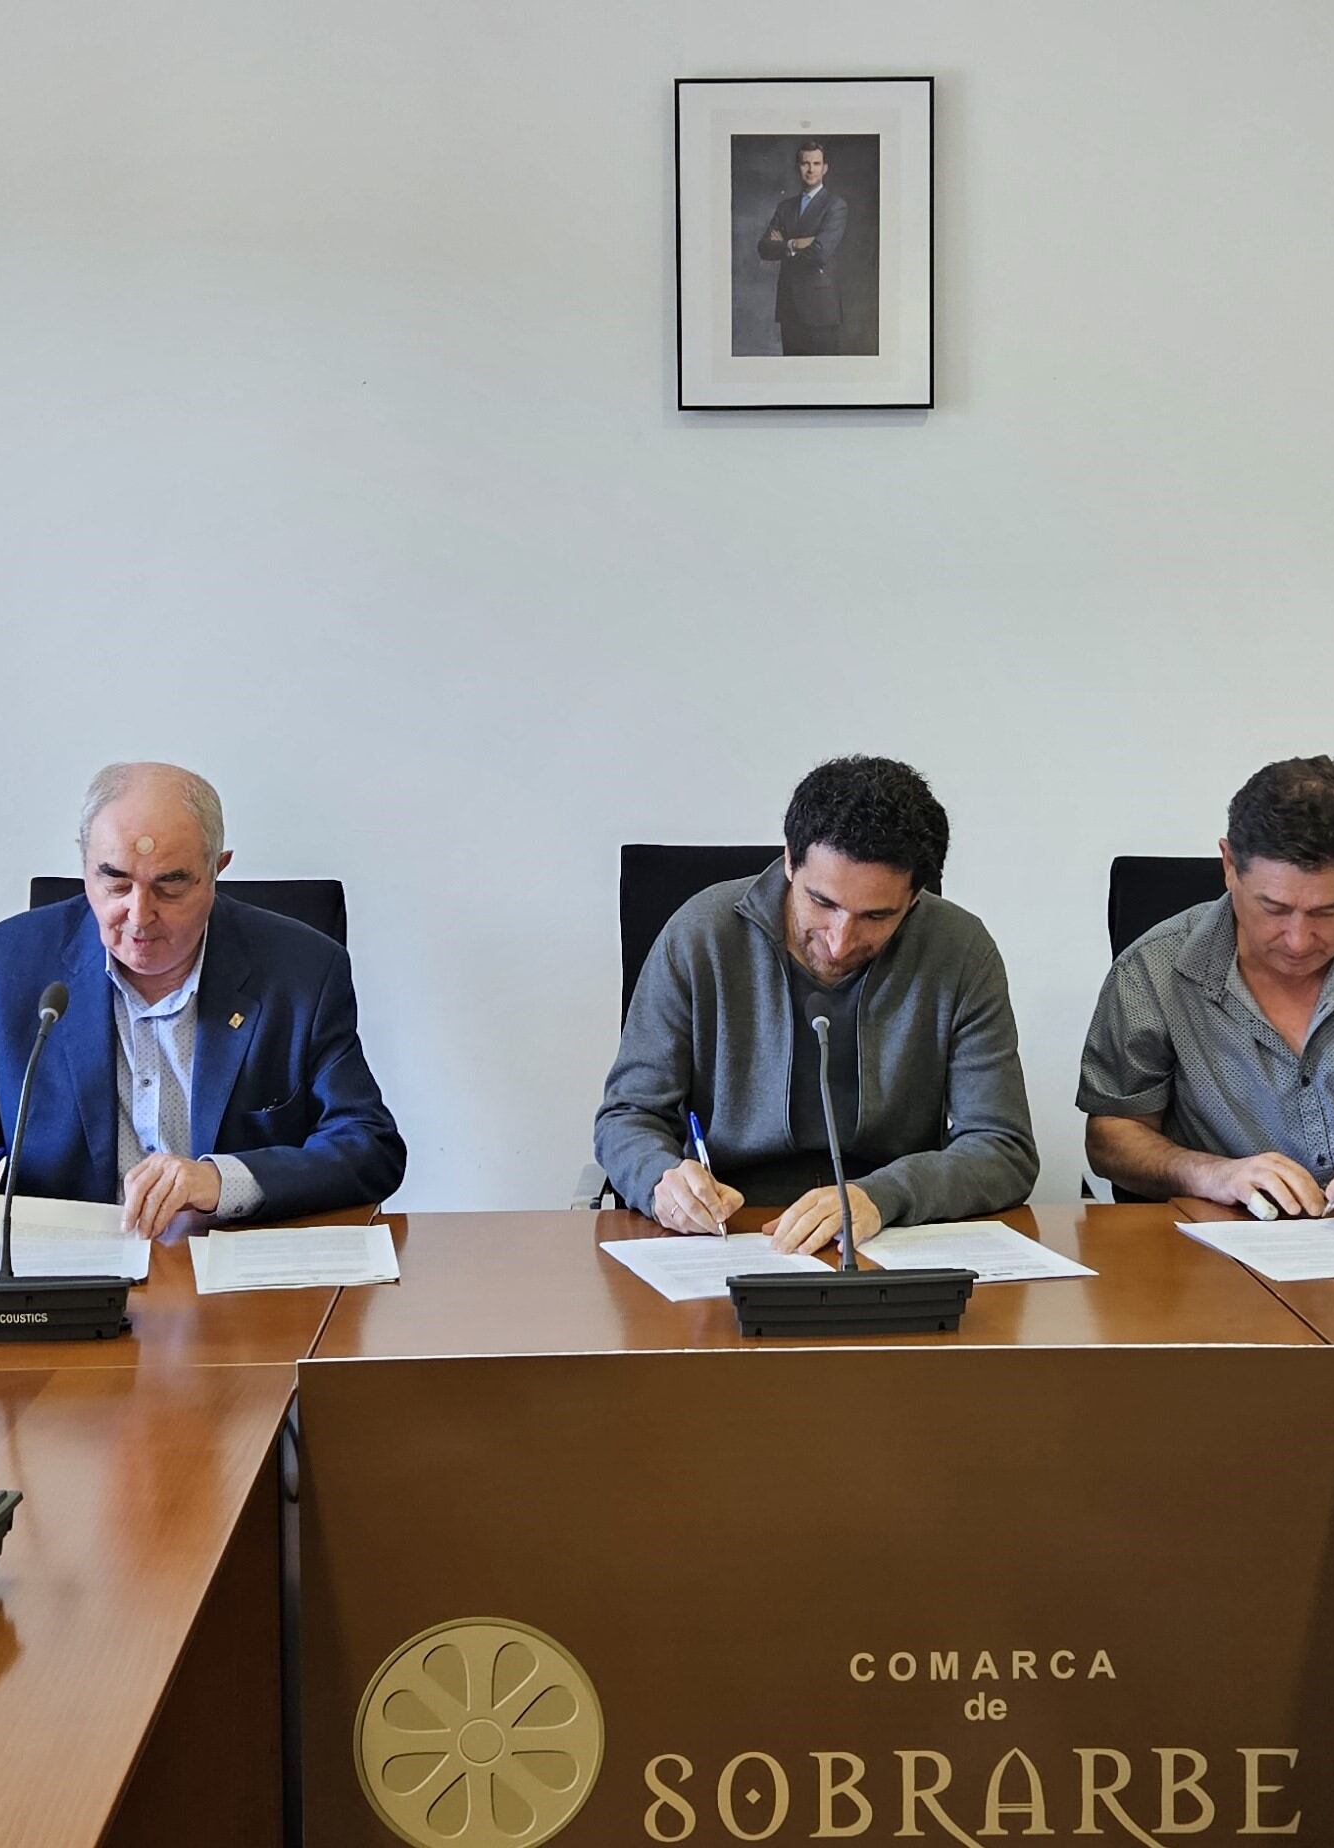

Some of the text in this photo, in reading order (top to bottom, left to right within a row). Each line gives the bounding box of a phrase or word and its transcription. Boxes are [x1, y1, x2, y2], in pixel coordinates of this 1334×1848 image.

[849, 1649, 1117, 1682] COMARCA
[963, 1691, 1008, 1722] de
[643, 1746, 1302, 1848] SOBRARBE
